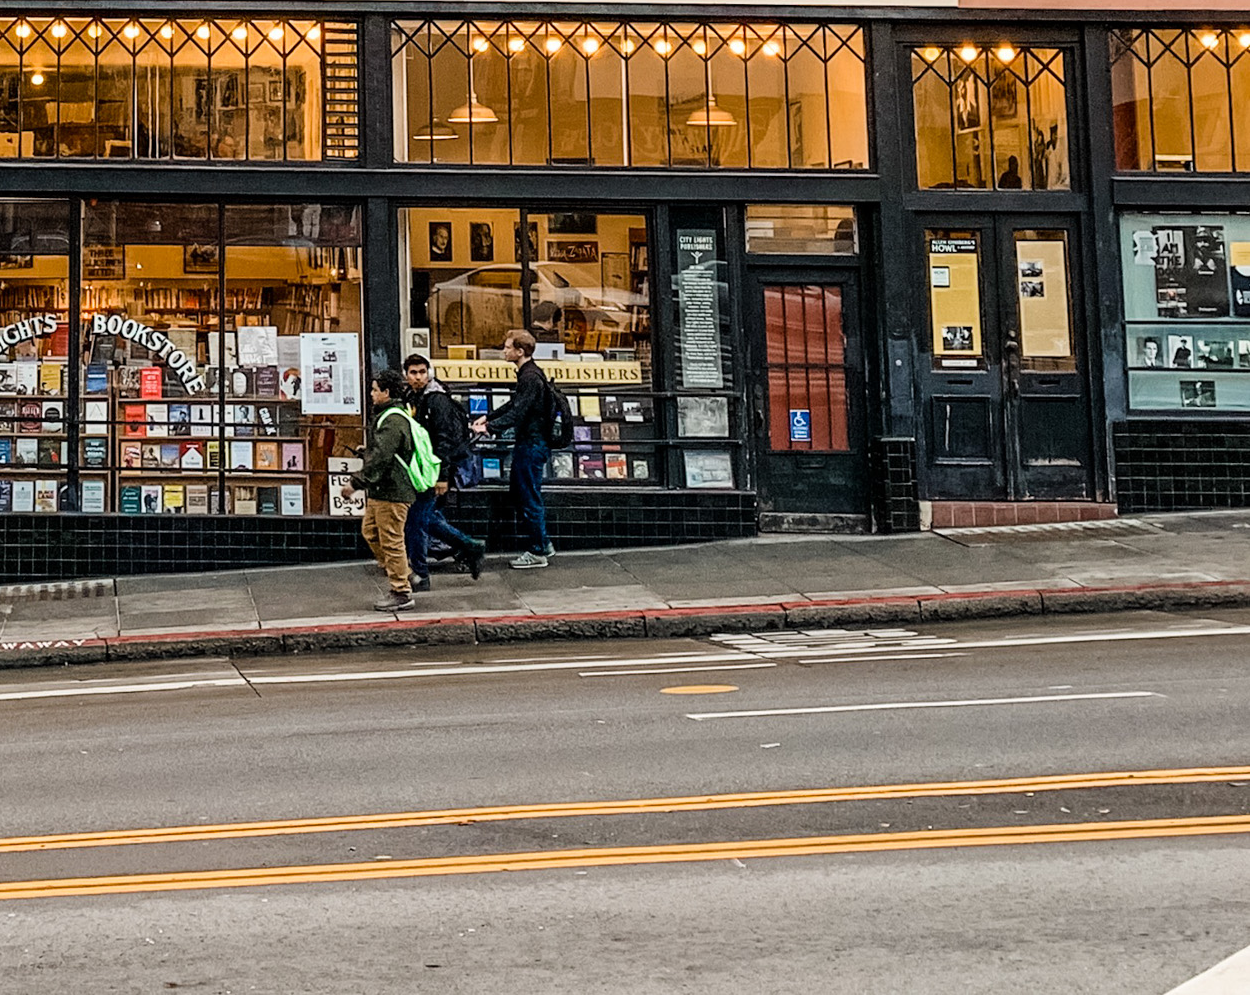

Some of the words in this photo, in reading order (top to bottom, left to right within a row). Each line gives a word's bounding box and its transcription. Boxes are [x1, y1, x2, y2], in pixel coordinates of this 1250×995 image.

[931, 244, 957, 253] HOWL
[92, 312, 206, 396] BOOKSTORE
[340, 461, 349, 472] 3
